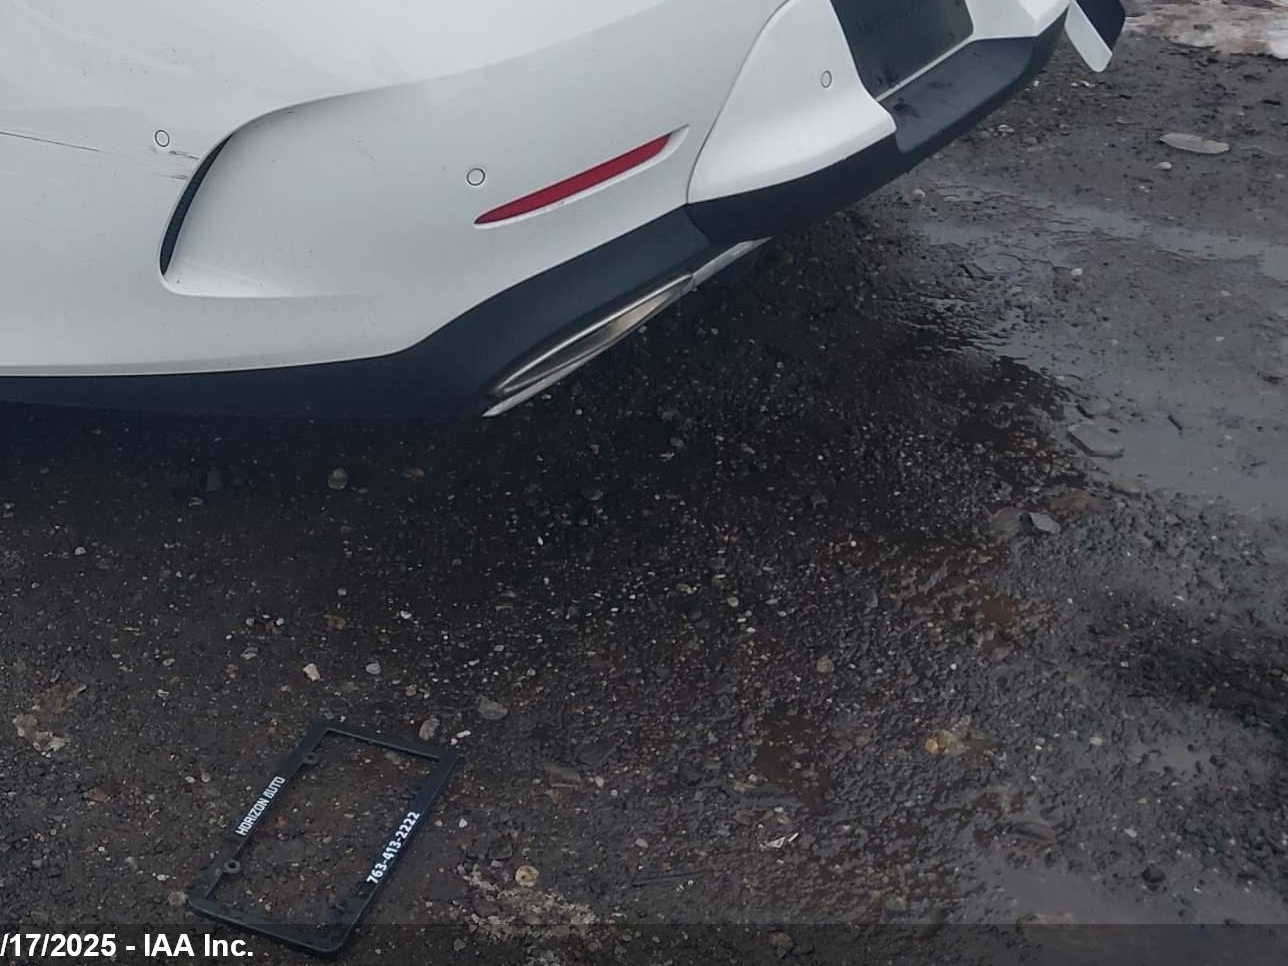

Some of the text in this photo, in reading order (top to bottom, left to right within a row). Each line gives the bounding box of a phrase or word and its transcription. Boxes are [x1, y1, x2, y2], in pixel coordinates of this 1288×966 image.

[235, 776, 286, 836] HORIZON AUTO
[366, 811, 420, 884] 763-413-2222
